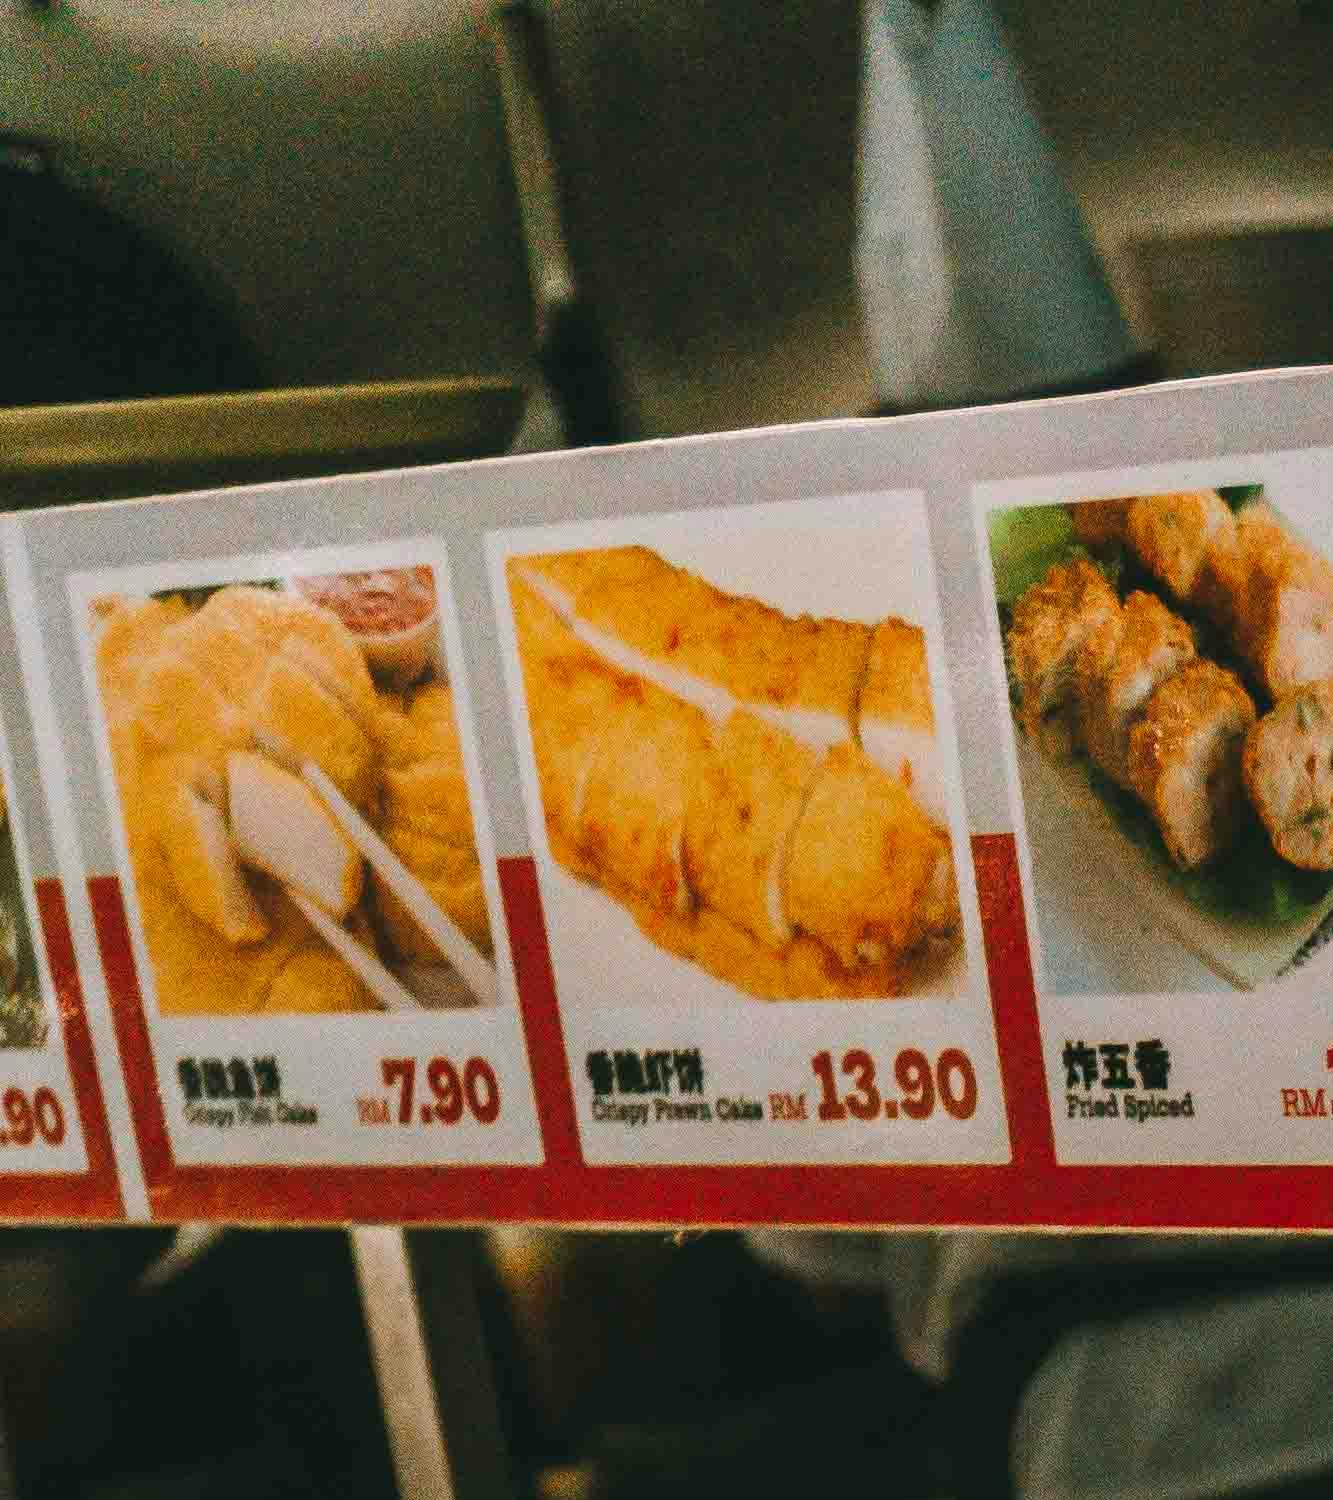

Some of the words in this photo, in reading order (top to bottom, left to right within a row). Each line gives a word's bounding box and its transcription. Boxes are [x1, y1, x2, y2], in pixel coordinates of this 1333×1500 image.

[767, 1091, 809, 1120] RM
[812, 1046, 978, 1121] 13.90
[1063, 1040, 1171, 1090] 炸五香
[379, 1055, 501, 1127] 7.90
[1066, 1092, 1119, 1119] Fried
[1123, 1092, 1196, 1123] Spiced
[1280, 1087, 1327, 1119] RM
